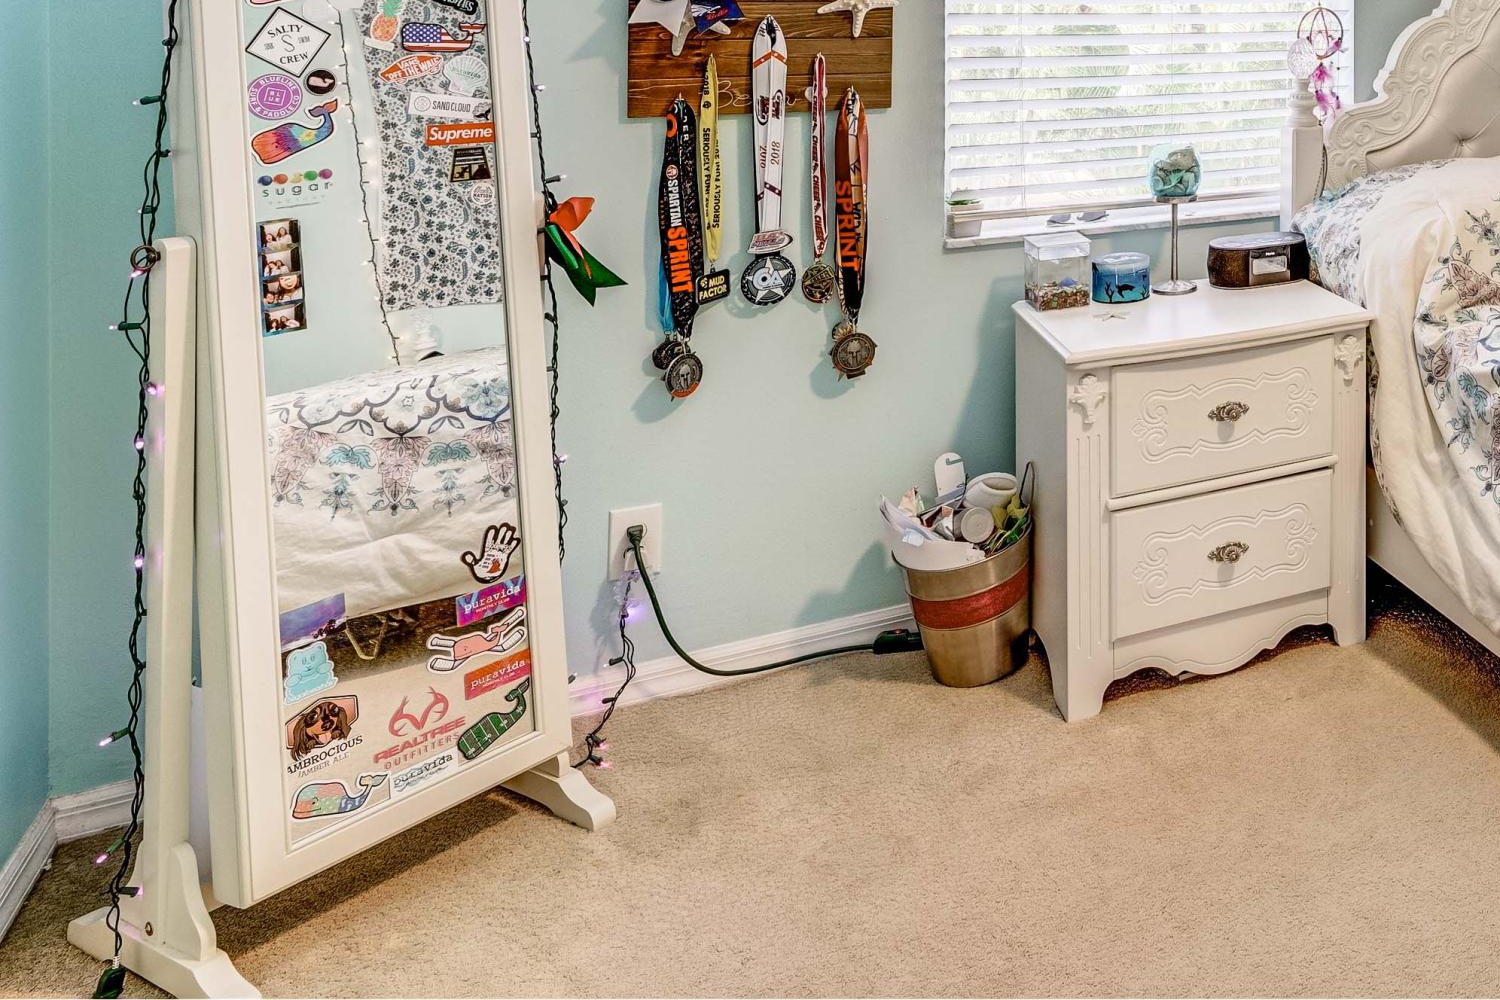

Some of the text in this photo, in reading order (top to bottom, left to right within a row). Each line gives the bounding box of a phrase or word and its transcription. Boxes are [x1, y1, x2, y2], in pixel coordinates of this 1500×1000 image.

[267, 24, 303, 38] SALTY
[280, 52, 309, 65] CREW
[404, 64, 420, 77] THE
[259, 75, 297, 91] BLUELINE
[432, 100, 471, 113] SAND CLOUD
[429, 127, 493, 143] Supreme
[702, 127, 711, 172] SERIOUSLY
[771, 140, 781, 166] 2018
[813, 174, 821, 202] CHEER
[712, 185, 722, 229] SERIOUSLY
[667, 179, 694, 293] SPARTAN SPRINT
[814, 213, 823, 241] CHEER
[835, 180, 859, 271] SPRINT
[699, 285, 728, 300] FACTOR
[708, 274, 725, 288] MUD
[464, 583, 521, 615] puravida
[471, 659, 526, 690] puravida
[373, 716, 466, 763] REALTREE
[384, 731, 461, 770] OUTFITTERS
[393, 754, 453, 788] puravida
